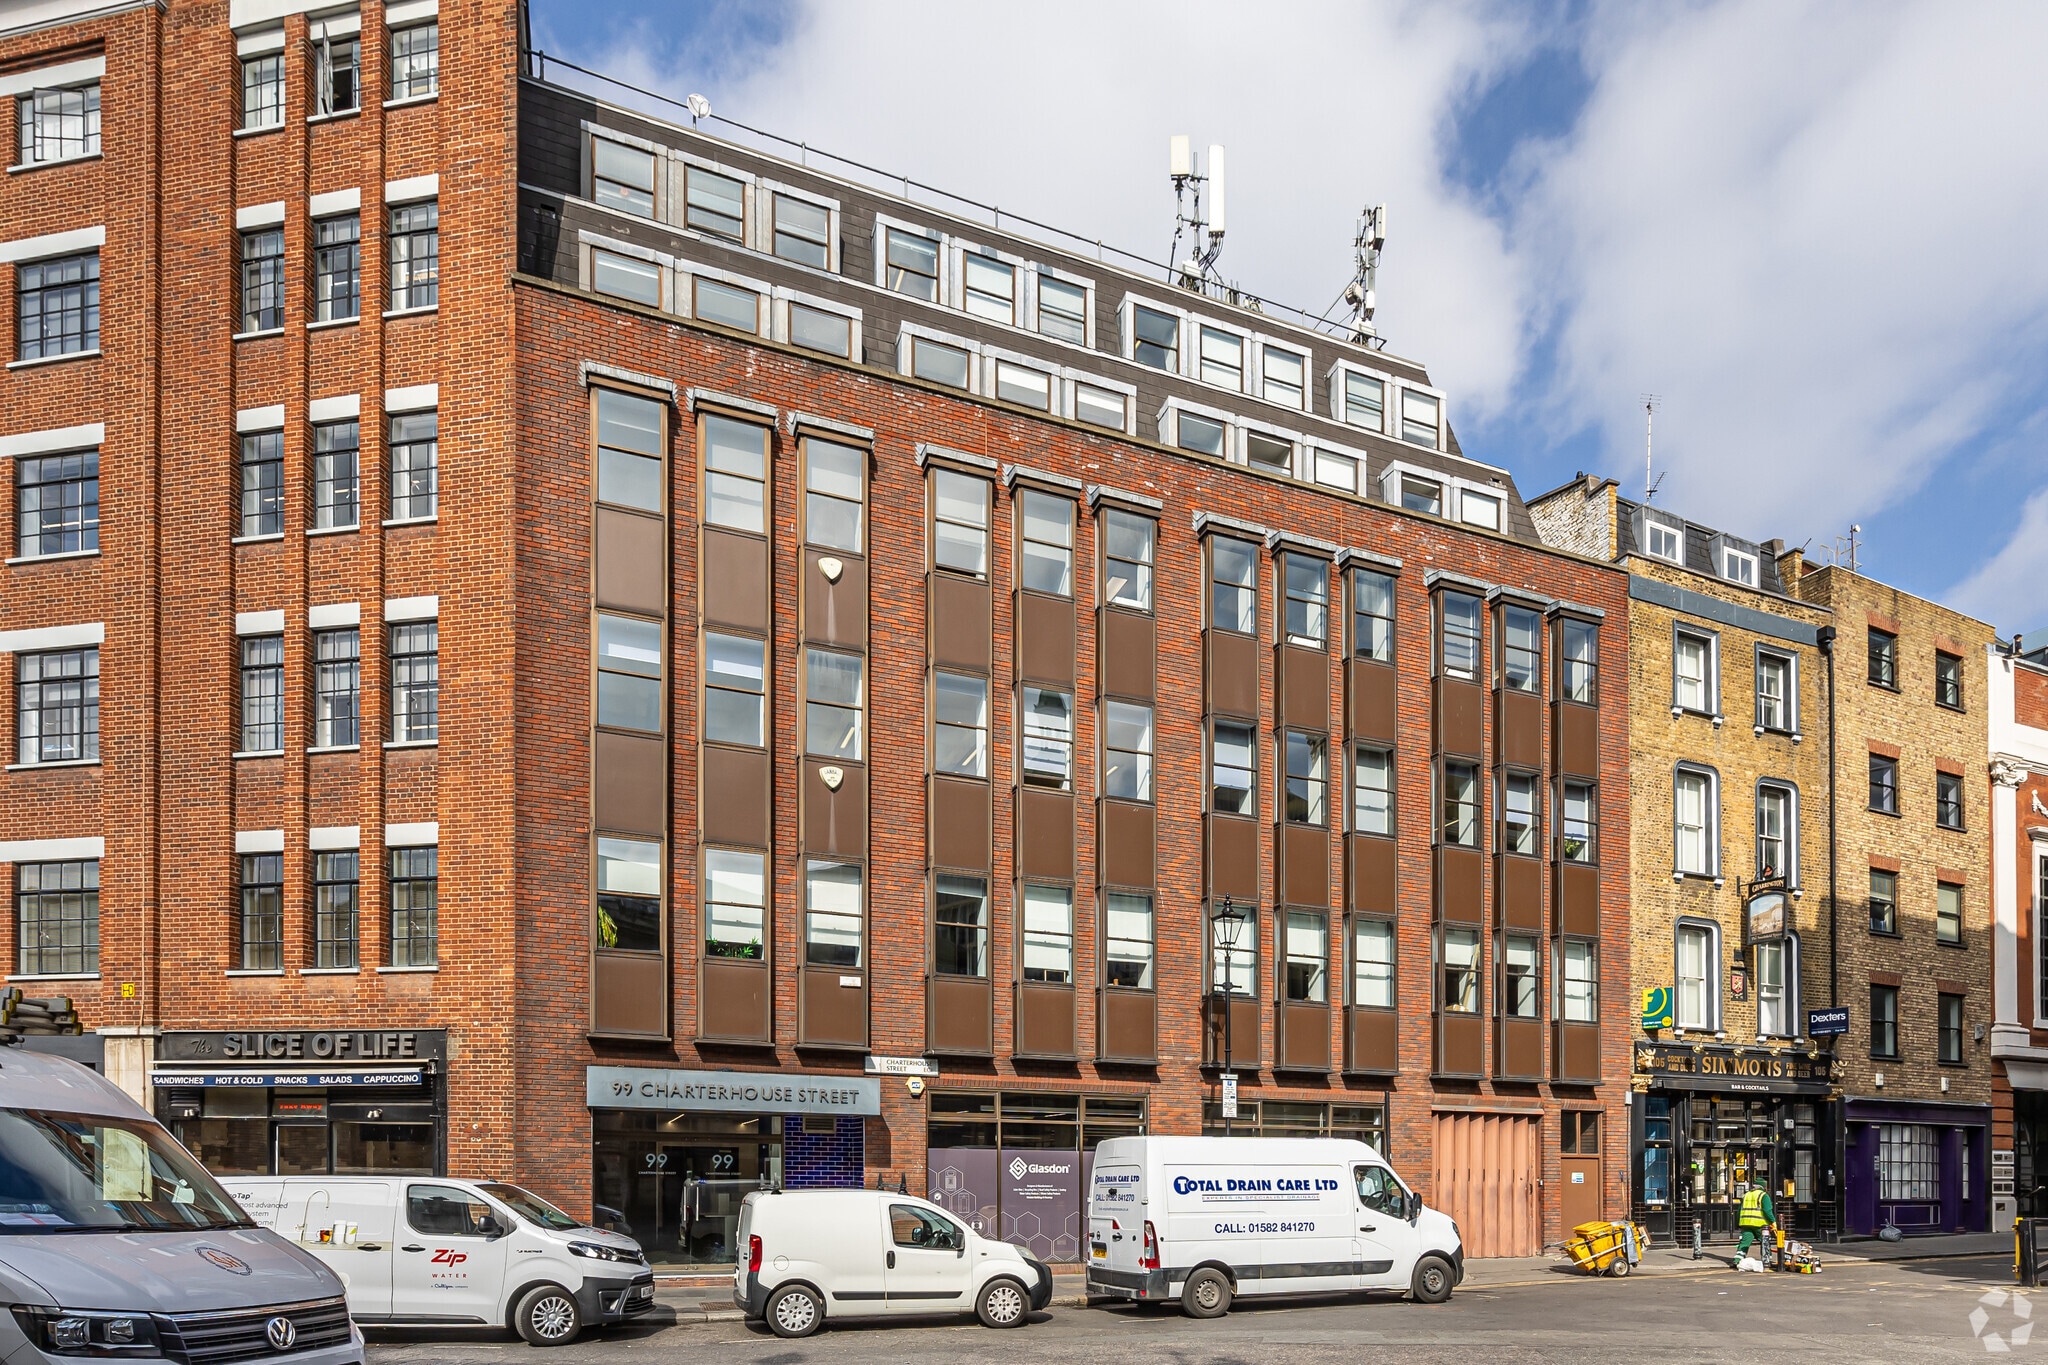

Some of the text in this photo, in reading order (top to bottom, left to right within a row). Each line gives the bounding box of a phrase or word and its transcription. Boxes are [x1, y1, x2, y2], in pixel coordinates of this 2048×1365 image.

[1811, 1013, 1846, 1023] Dexters
[191, 1033, 416, 1057] The SLICE OF LIFE
[886, 1059, 933, 1067] CHARTERHOUSE
[1702, 1056, 1782, 1077] SIMMONS
[153, 1074, 419, 1085] SANDWICHES HOT & COLD SNACKS SALADS CAPPUCCINO
[612, 1080, 860, 1105] 99 CHARTERHOUSE STREET
[645, 1153, 668, 1168] 99
[712, 1154, 734, 1169] 99
[1028, 1164, 1070, 1174] Glasdon
[1173, 1176, 1338, 1195] TOTAL DRAIN CARE LTD
[1214, 1222, 1315, 1234] CALL: 01582 841270
[431, 1249, 468, 1268] Zip
